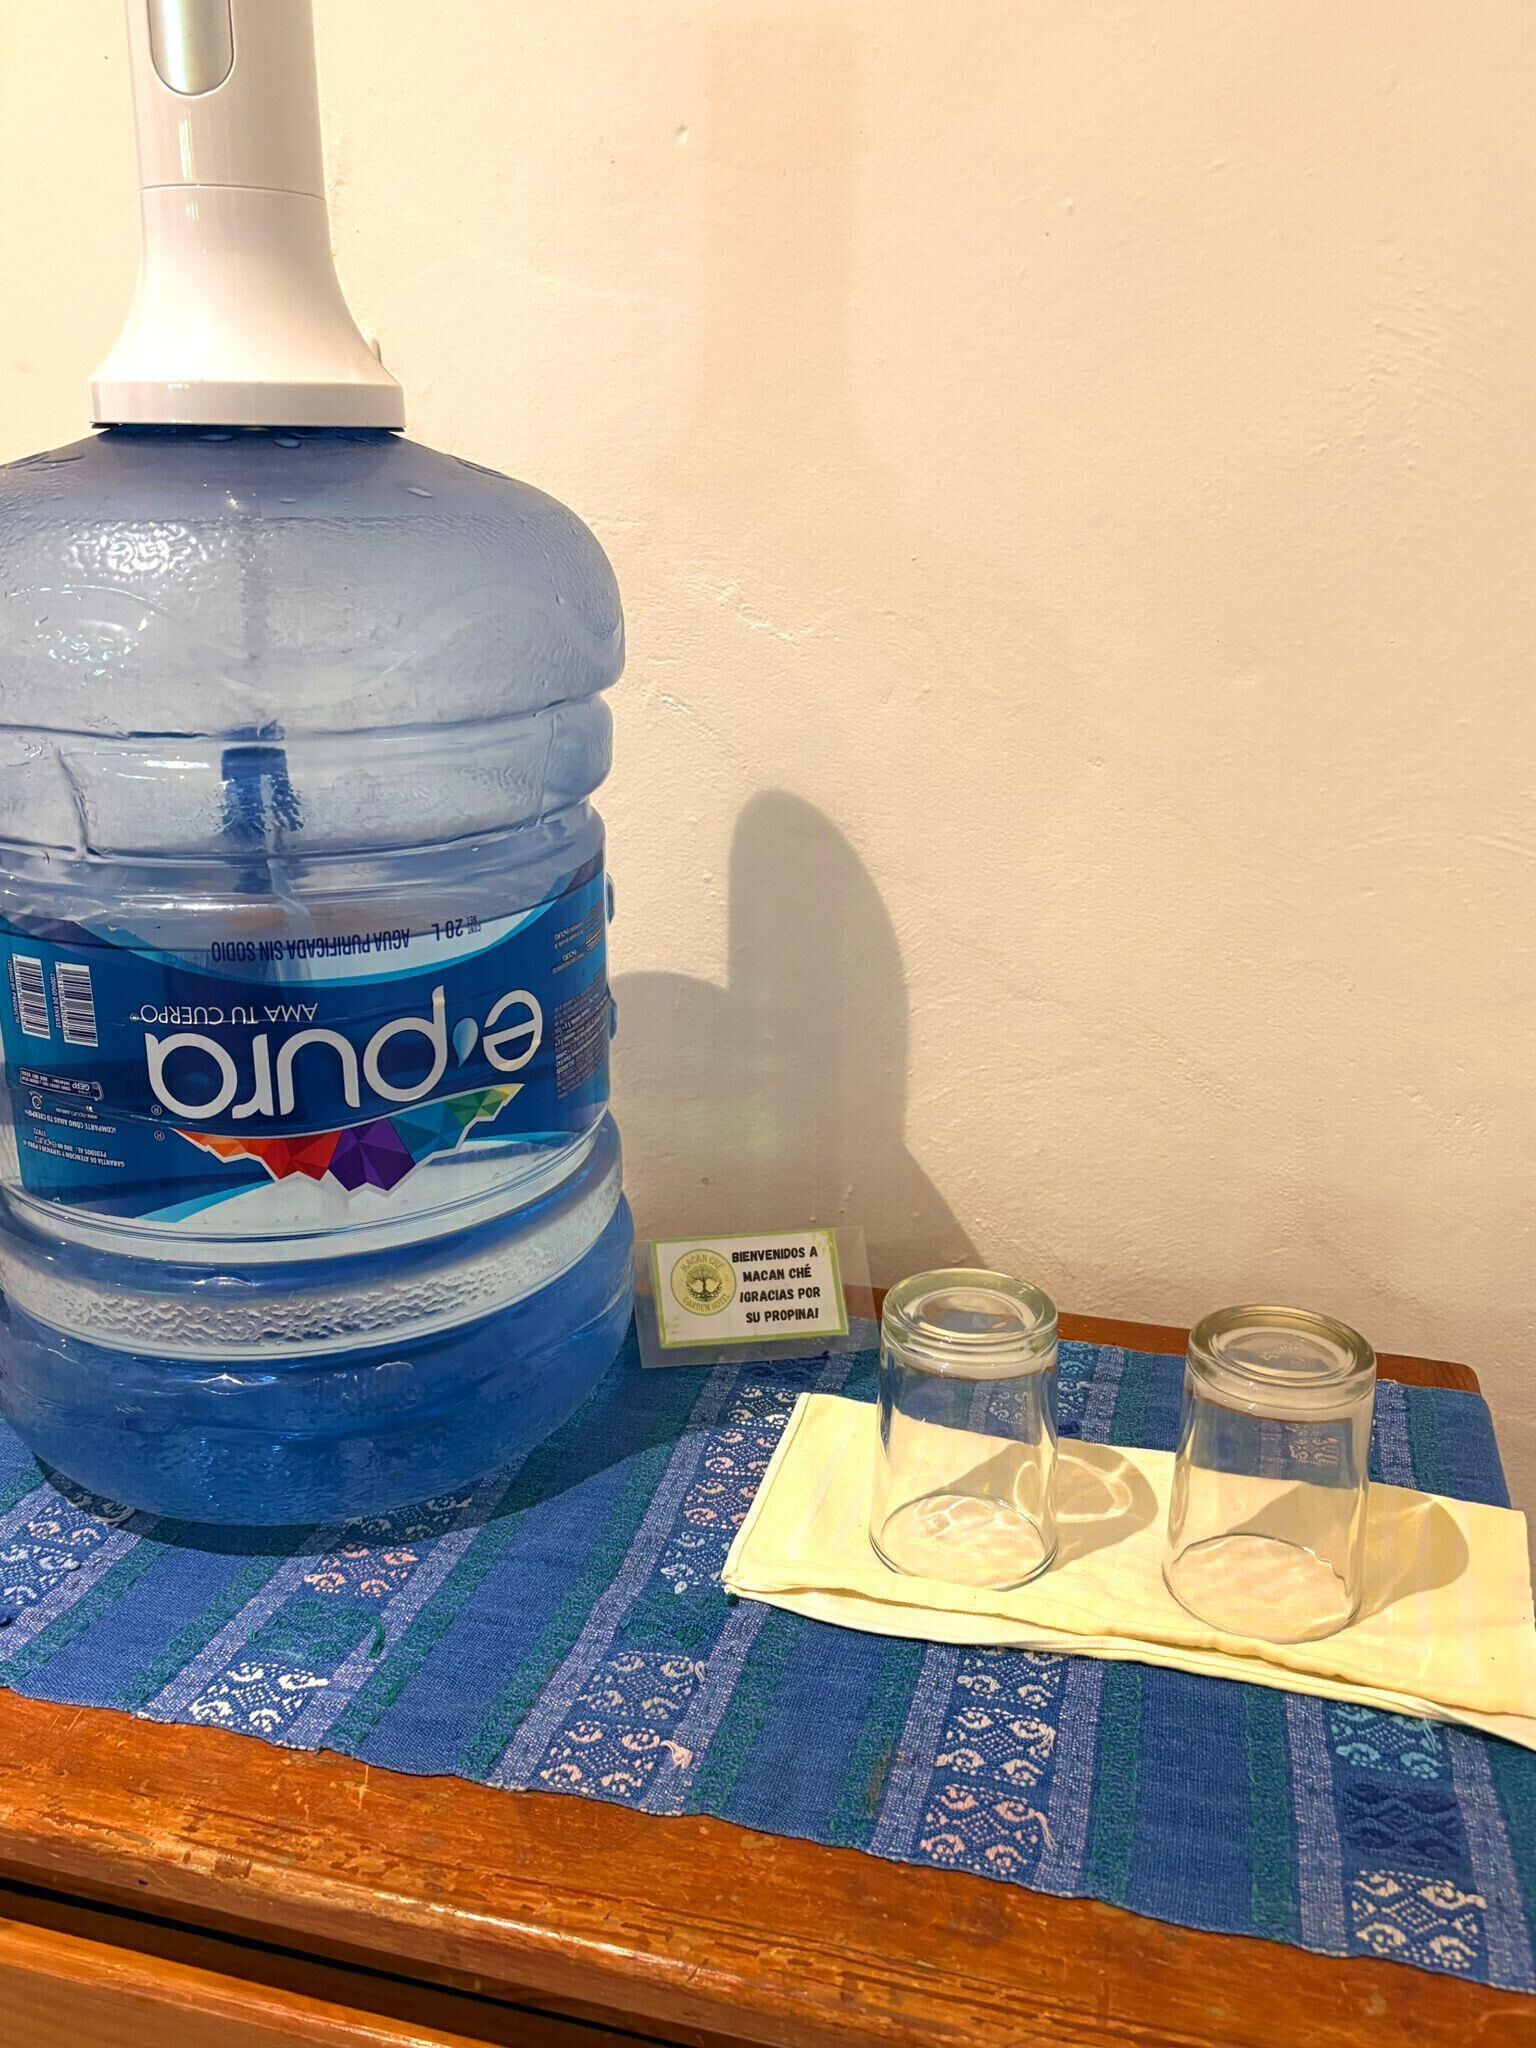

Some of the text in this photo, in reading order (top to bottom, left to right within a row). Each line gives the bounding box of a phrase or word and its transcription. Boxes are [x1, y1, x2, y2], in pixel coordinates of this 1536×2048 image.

[431, 918, 463, 941] 20 L
[211, 928, 410, 962] AGUA PURIFICADA SIN SODIO
[140, 1003, 319, 1025] AMA TU CUERPO
[84, 1148, 107, 1158] PEDIDOS
[731, 1246, 818, 1263] BIENVENIDOS A
[742, 1263, 812, 1282] MACAN CHÉ
[797, 1286, 821, 1299] POR
[746, 1311, 760, 1323] SU
